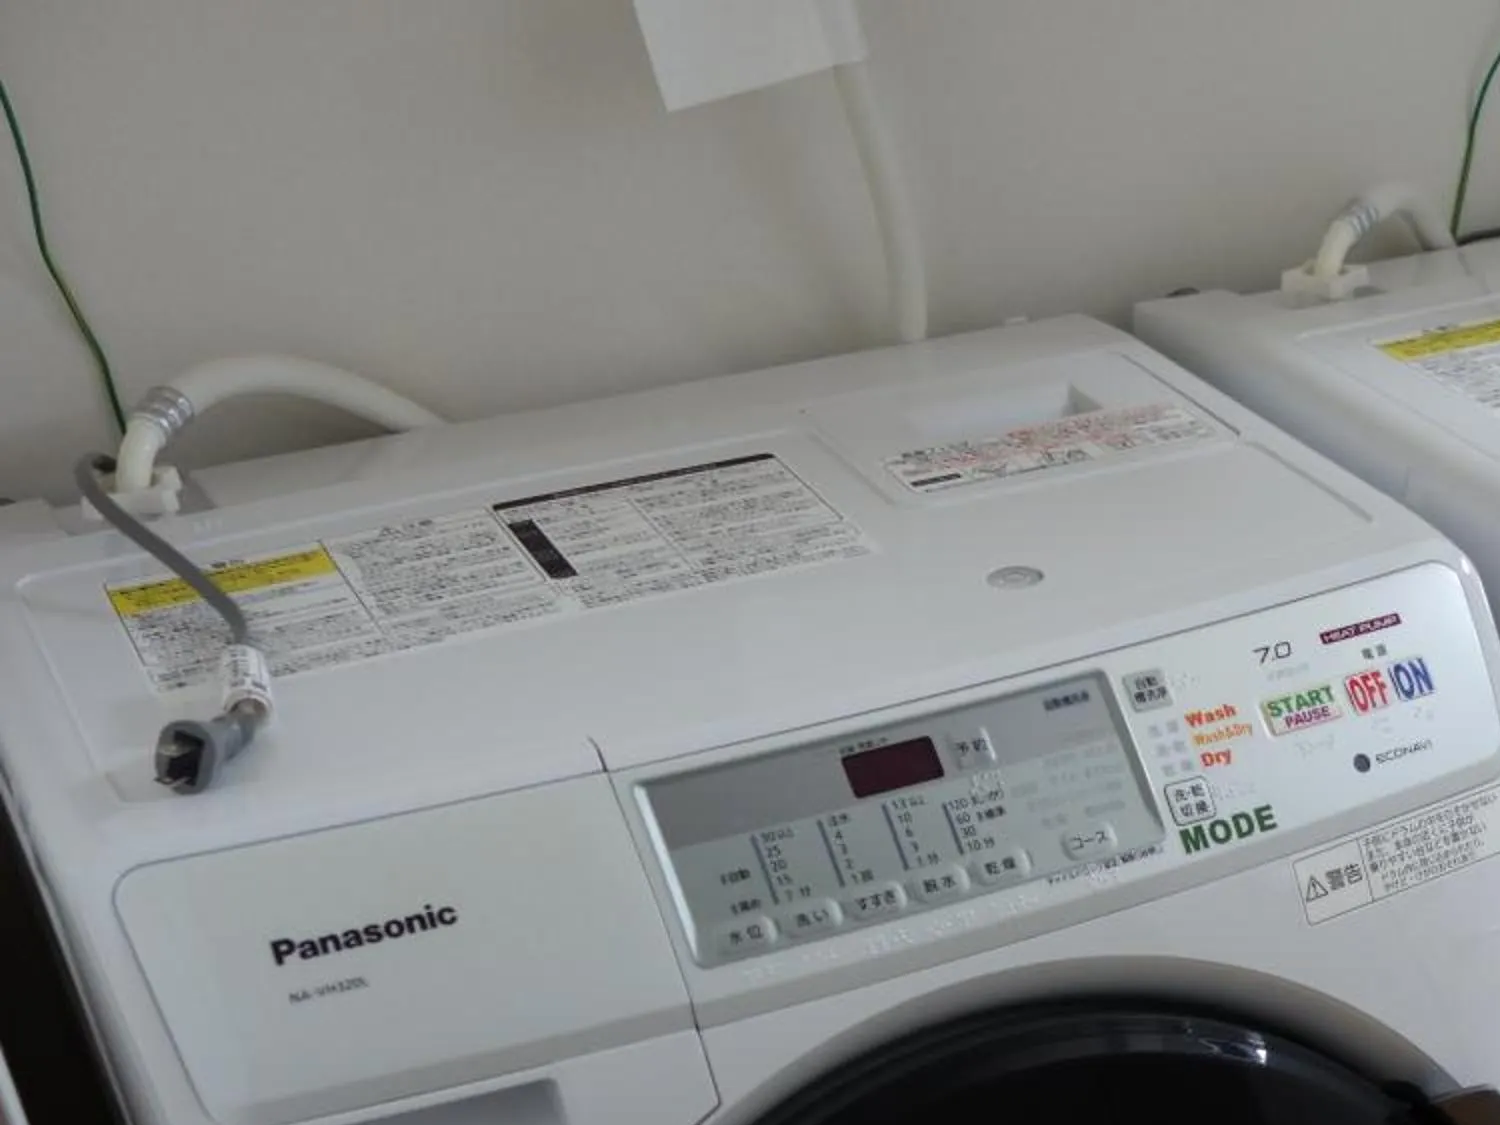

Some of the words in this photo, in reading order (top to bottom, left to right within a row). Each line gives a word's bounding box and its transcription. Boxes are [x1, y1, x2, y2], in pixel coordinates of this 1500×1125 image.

[1253, 641, 1292, 664] 7.0
[1350, 671, 1388, 712] OFF
[1394, 658, 1434, 700] ON
[1184, 703, 1237, 728] Wash
[1267, 685, 1335, 717] START
[1284, 706, 1331, 729] PAUSE
[1201, 750, 1232, 767] Dry
[1179, 804, 1278, 855] MODE
[270, 904, 458, 966] Panasonic
